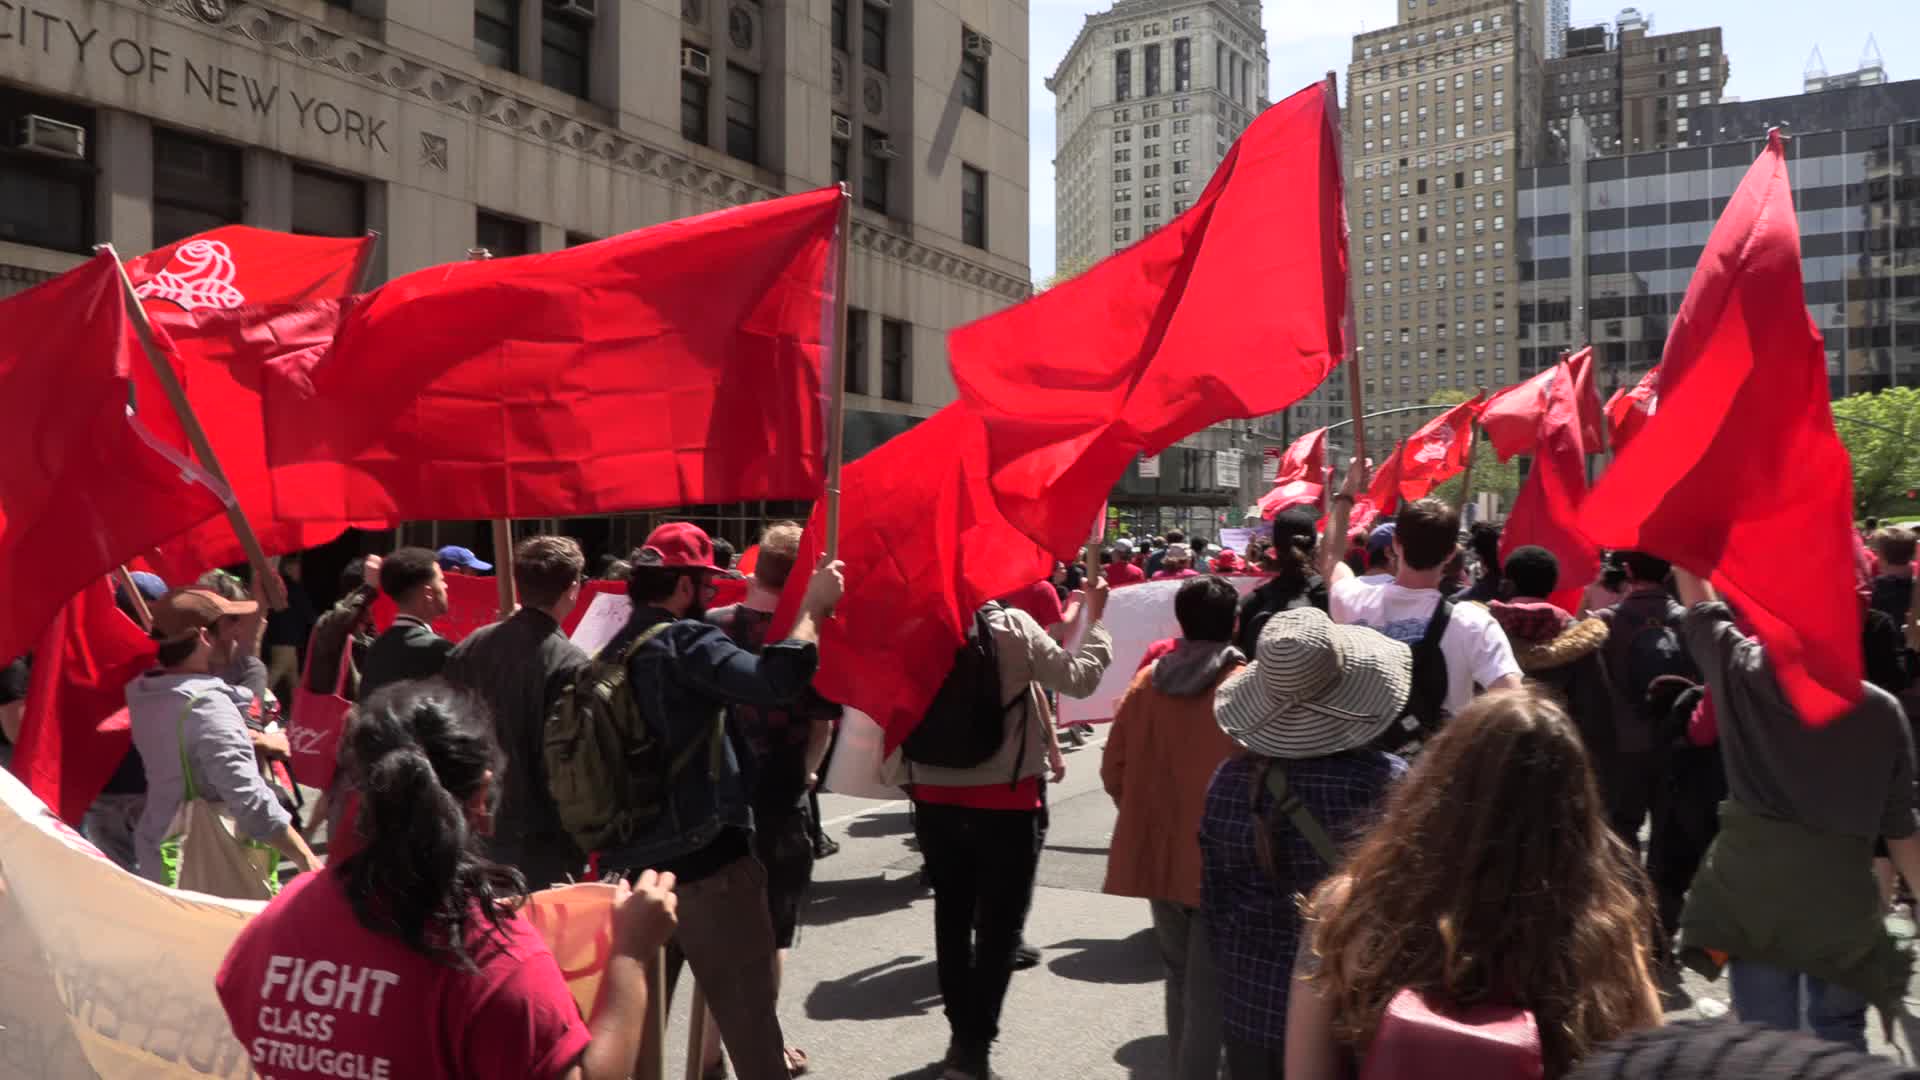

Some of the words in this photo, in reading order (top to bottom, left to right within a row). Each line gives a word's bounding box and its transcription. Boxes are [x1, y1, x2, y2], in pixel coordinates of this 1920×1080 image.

[109, 38, 171, 84] OF
[184, 56, 279, 117] NEW
[289, 90, 389, 153] YORK
[260, 955, 401, 1017] FIGHT
[258, 1005, 336, 1042] CLASS
[252, 1037, 392, 1080] STRUGGLE
